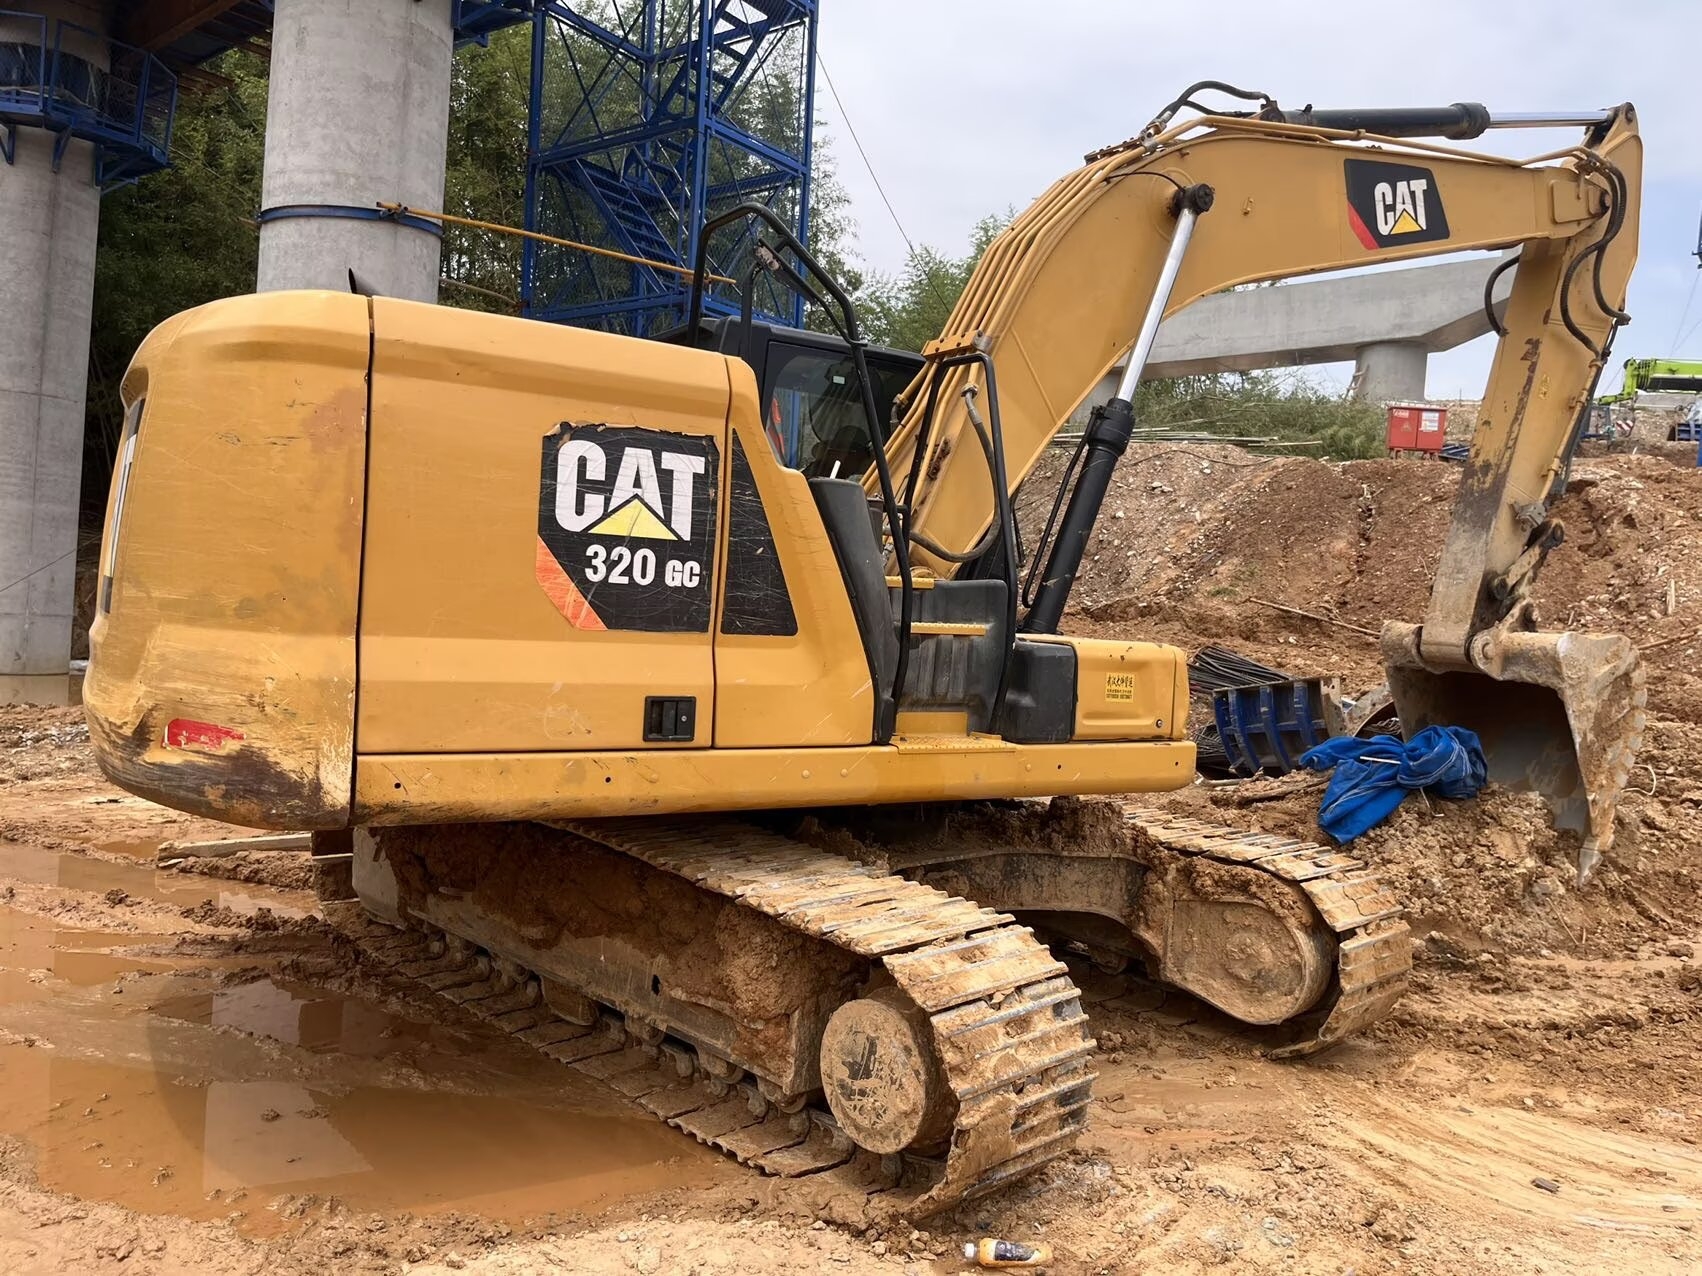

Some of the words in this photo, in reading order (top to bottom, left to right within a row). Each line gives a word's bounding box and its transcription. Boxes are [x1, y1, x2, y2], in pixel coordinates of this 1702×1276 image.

[1374, 179, 1427, 236] CAT
[555, 439, 705, 541] CAT
[585, 544, 656, 586] 320
[664, 560, 700, 588] GC
